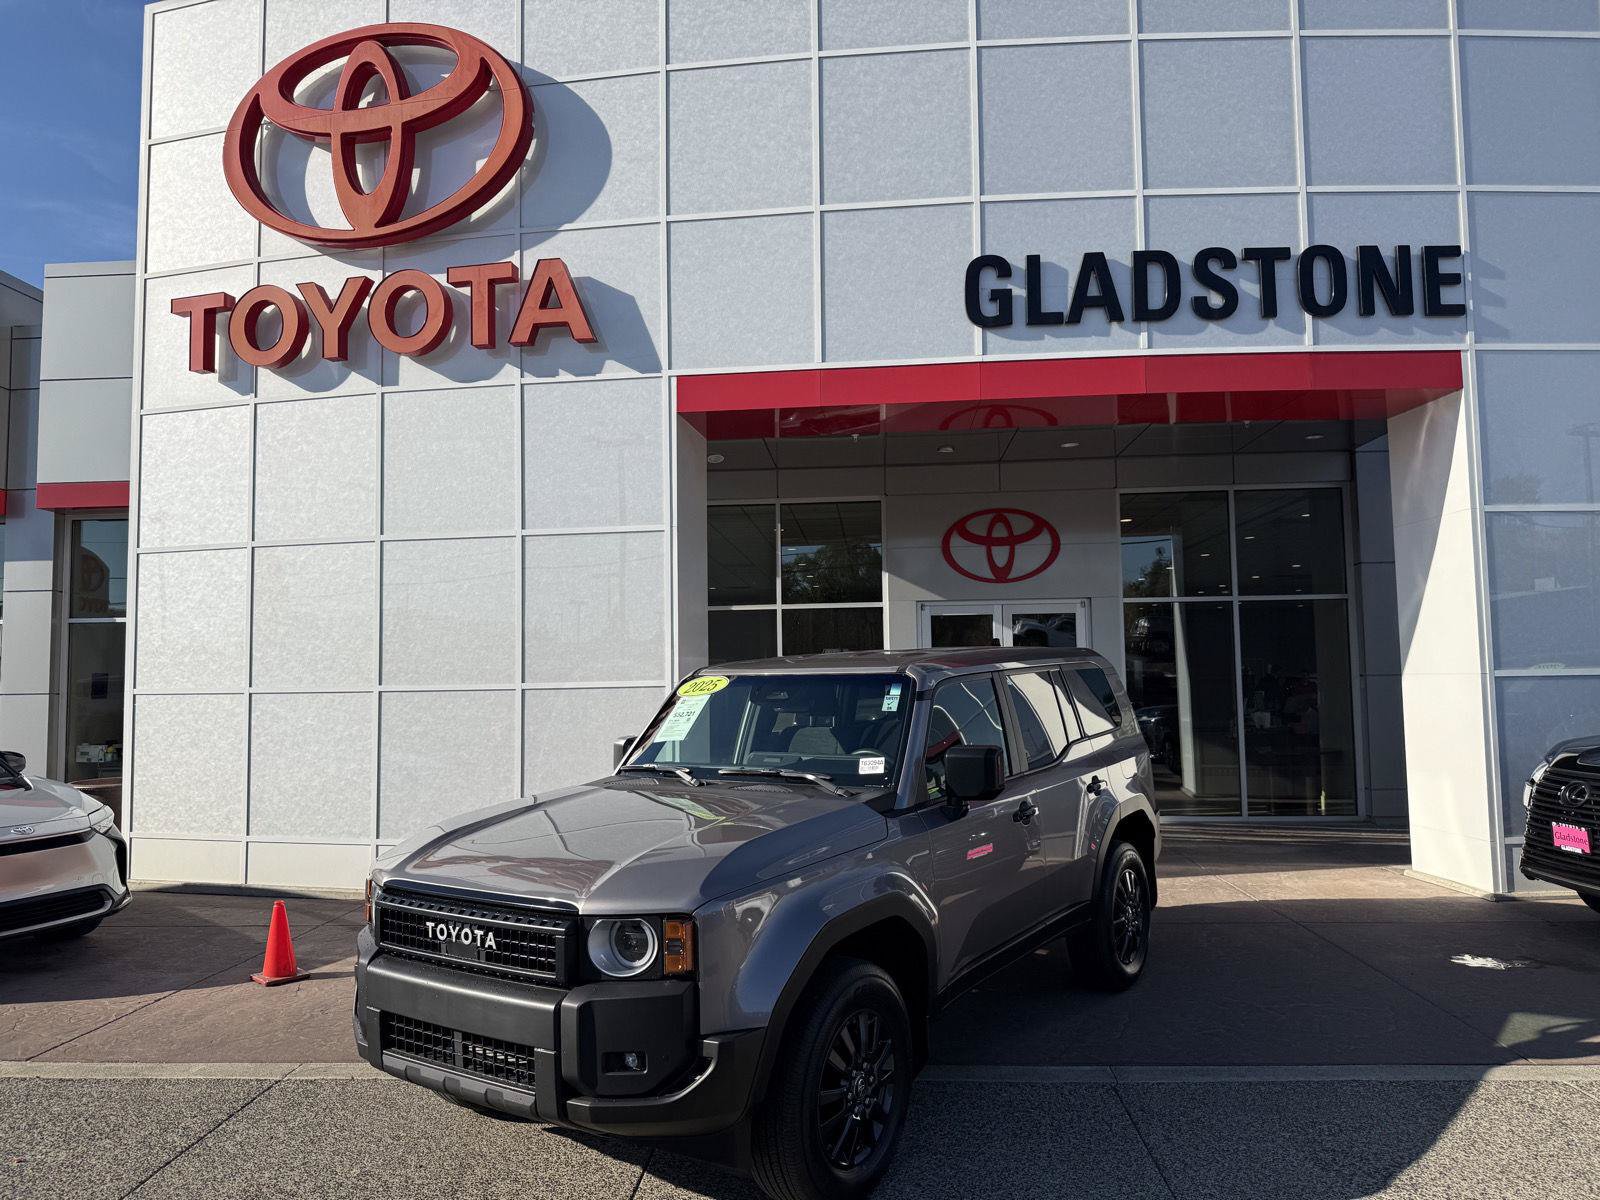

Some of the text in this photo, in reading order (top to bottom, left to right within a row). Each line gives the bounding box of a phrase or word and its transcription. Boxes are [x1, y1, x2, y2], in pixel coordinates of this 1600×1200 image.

[965, 244, 1466, 327] GLADSTONE
[171, 257, 597, 374] TOYOTA
[683, 679, 722, 694] 2025
[1554, 831, 1588, 846] Gladstone
[426, 921, 497, 950] TOYOTA
